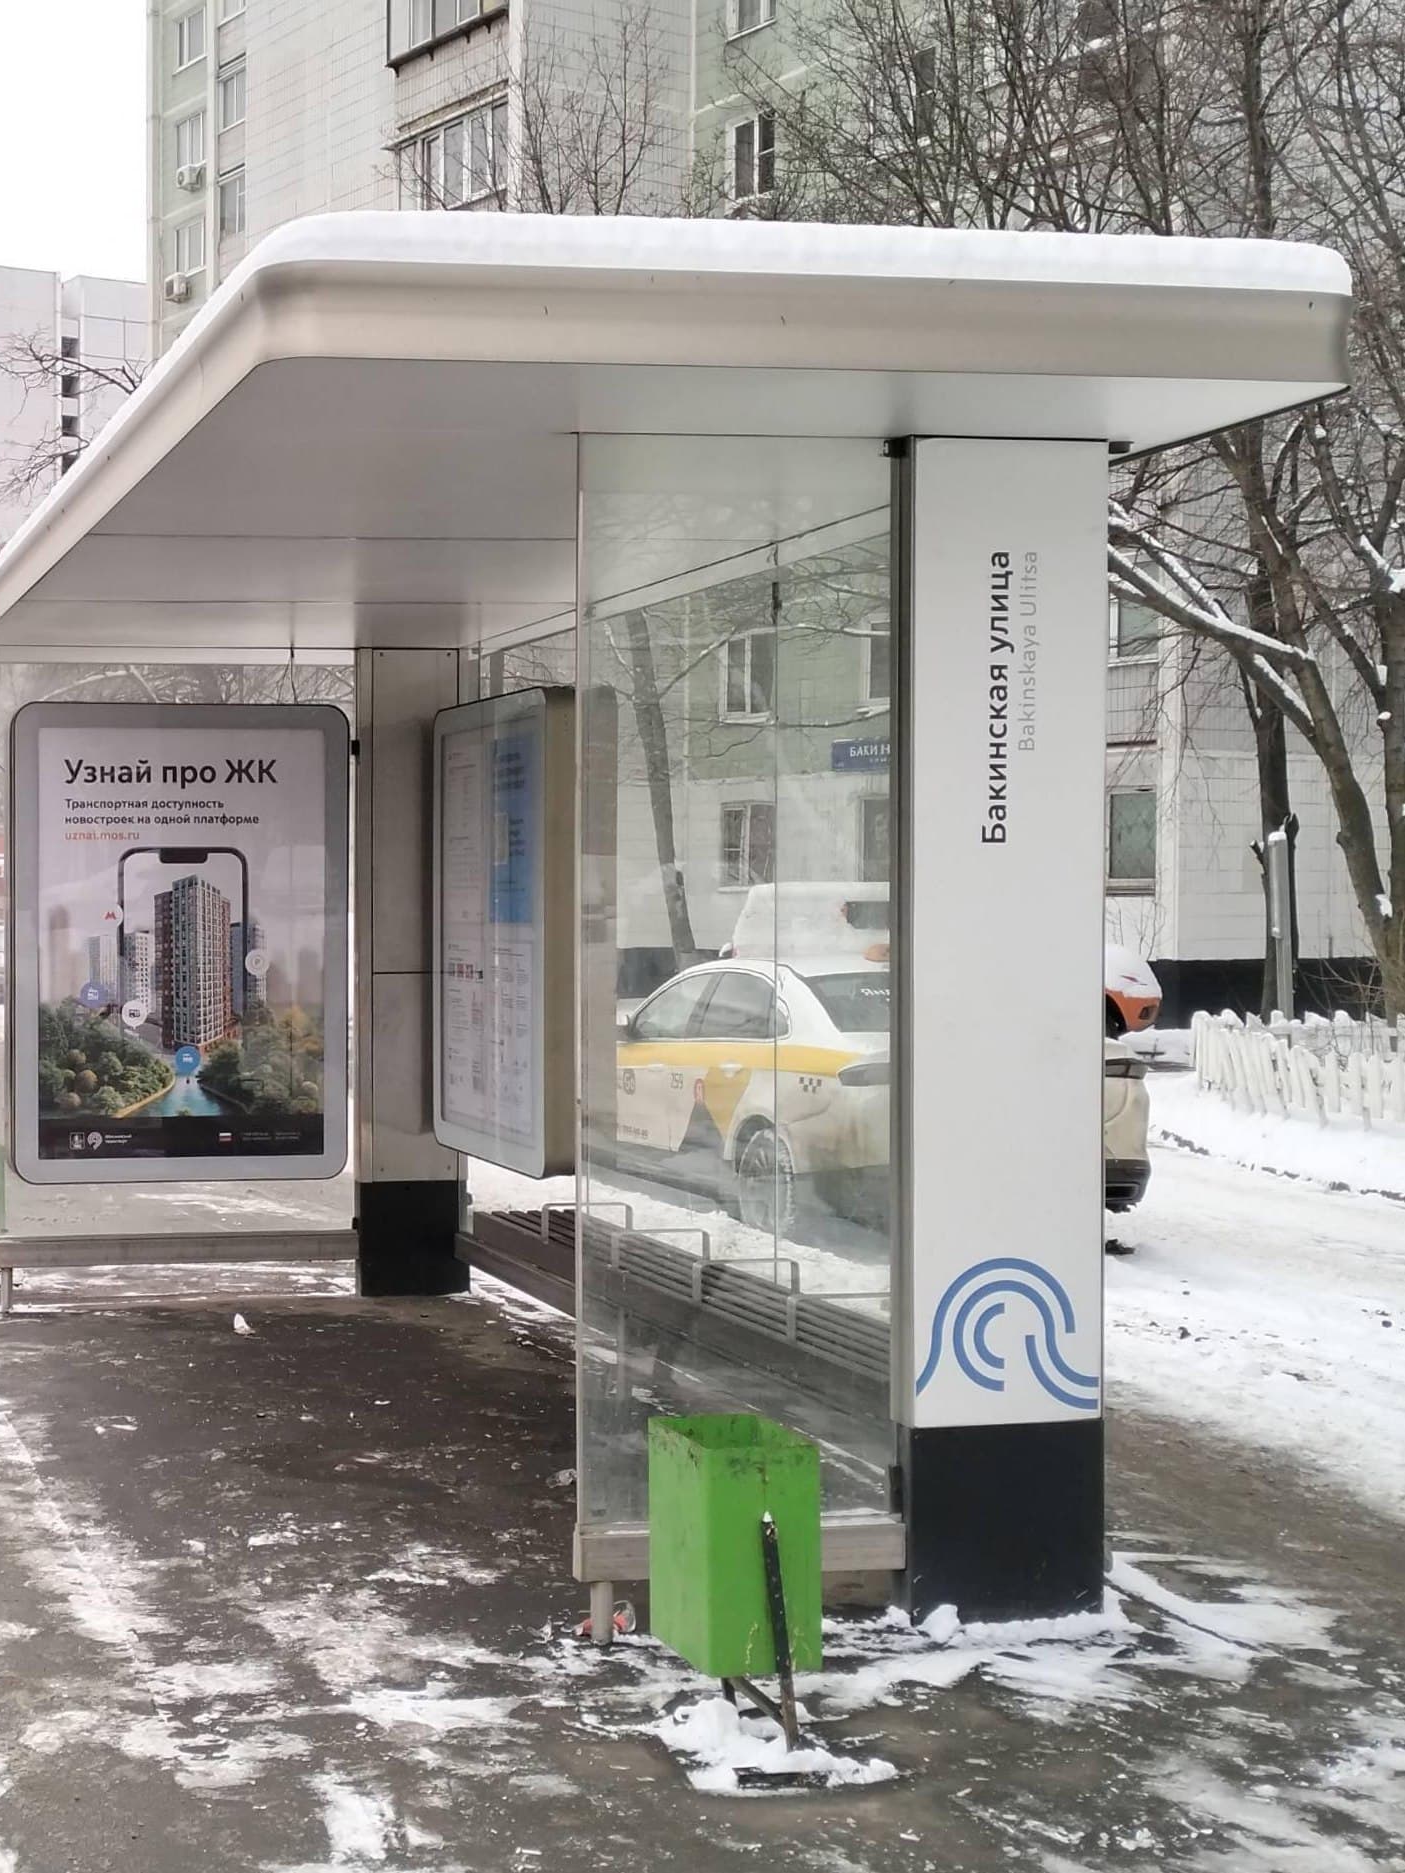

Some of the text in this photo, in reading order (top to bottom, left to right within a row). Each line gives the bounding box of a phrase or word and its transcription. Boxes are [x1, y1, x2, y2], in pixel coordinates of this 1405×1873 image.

[1017, 551, 1040, 751] Bakinskaya Ulitsa
[981, 551, 1014, 844] Бакинская улица
[849, 743, 891, 757] БАКИН
[64, 759, 278, 788] Узнай про ЖК
[64, 798, 225, 811] Транспортная доступность
[64, 814, 260, 827] новостроек на одной платформе
[64, 830, 140, 841] uznai.mos.ru
